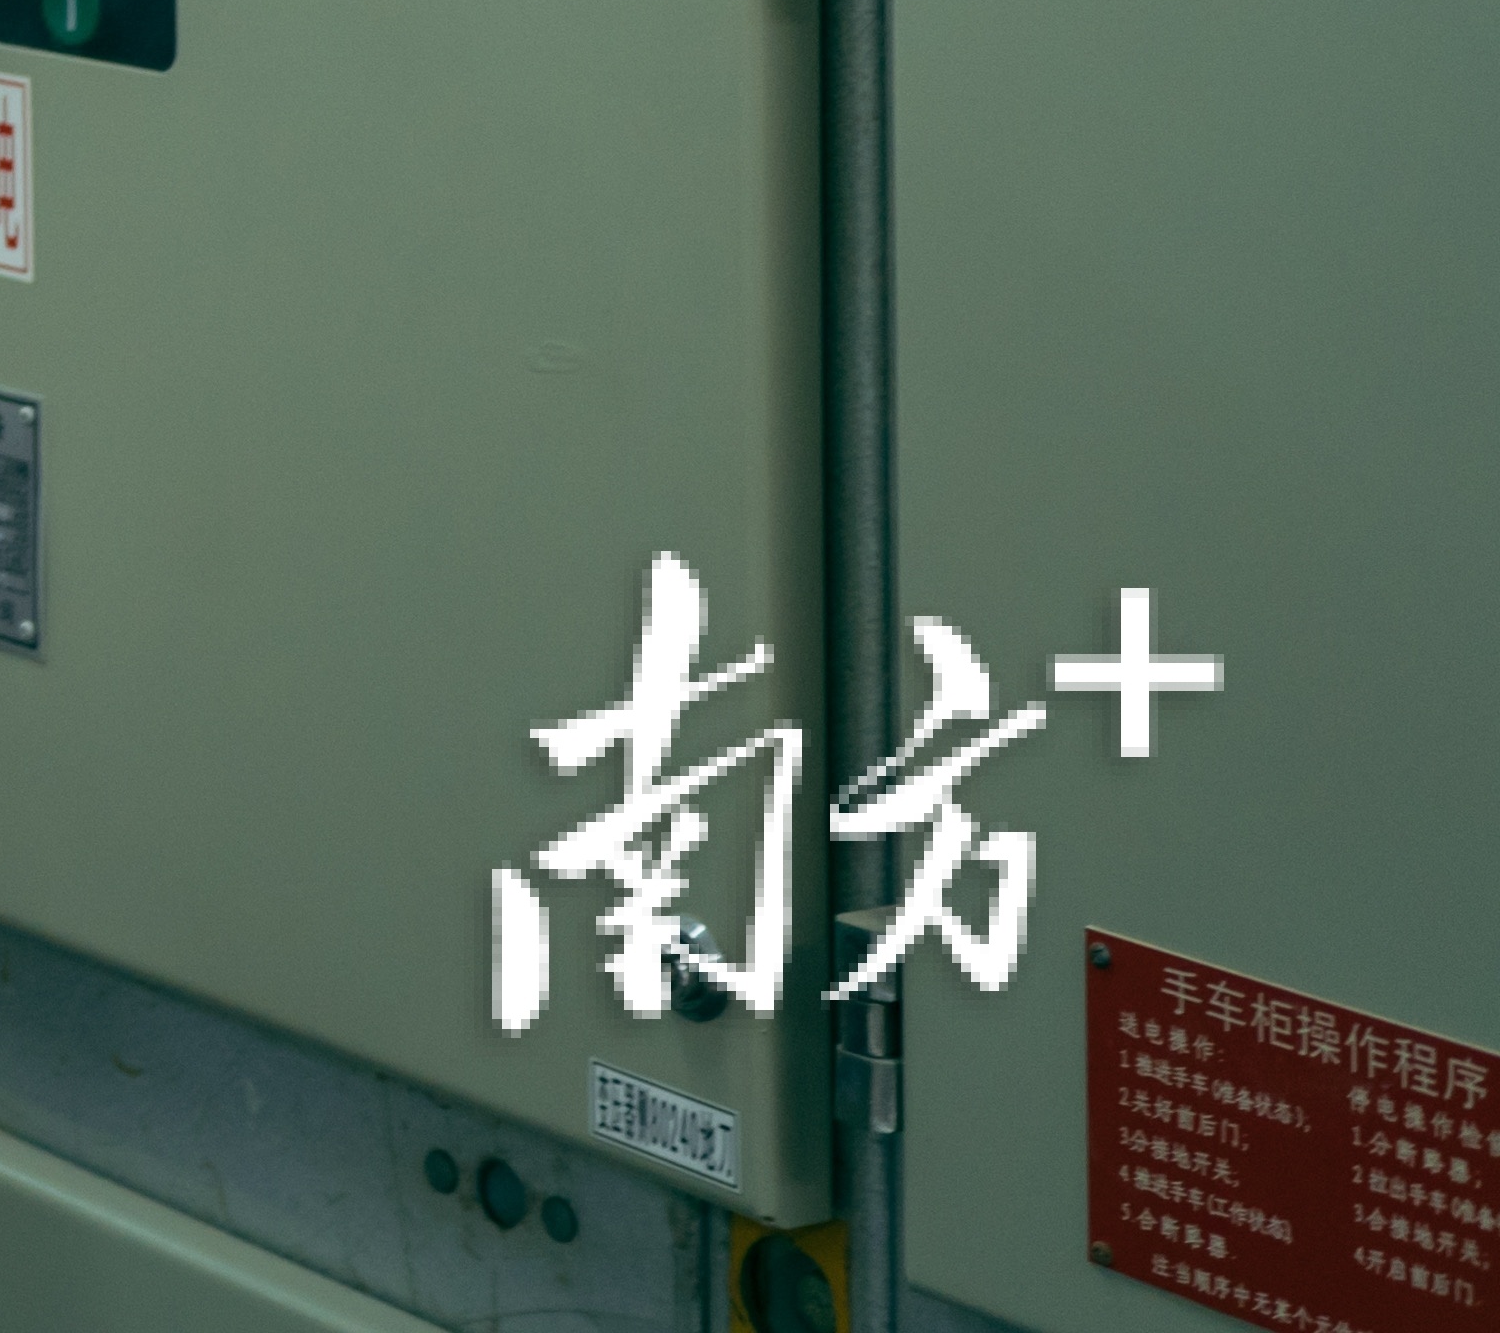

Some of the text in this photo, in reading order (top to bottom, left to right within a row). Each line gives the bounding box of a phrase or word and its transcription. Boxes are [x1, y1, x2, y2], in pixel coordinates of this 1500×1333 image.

[1160, 965, 1490, 1111] 手车柜操作程序
